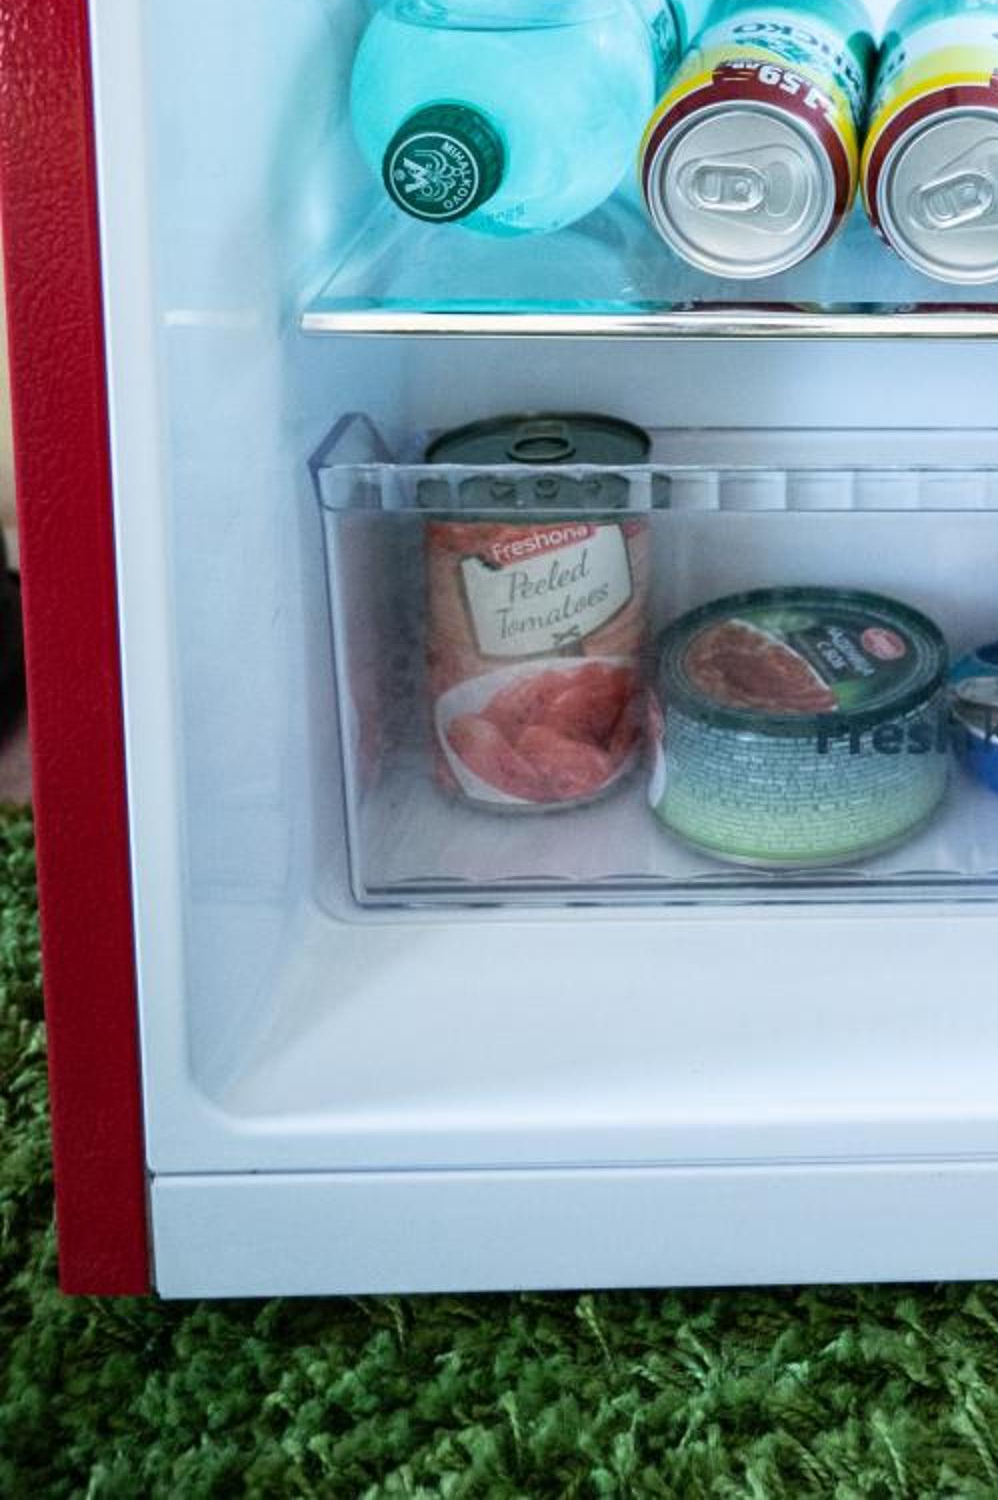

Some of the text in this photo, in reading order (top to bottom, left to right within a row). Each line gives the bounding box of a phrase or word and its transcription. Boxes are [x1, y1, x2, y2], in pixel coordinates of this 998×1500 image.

[441, 140, 473, 210] MIHALKOVO
[492, 524, 588, 564] Freshona
[507, 547, 591, 604] Peeled
[495, 581, 609, 640] Tomatoes
